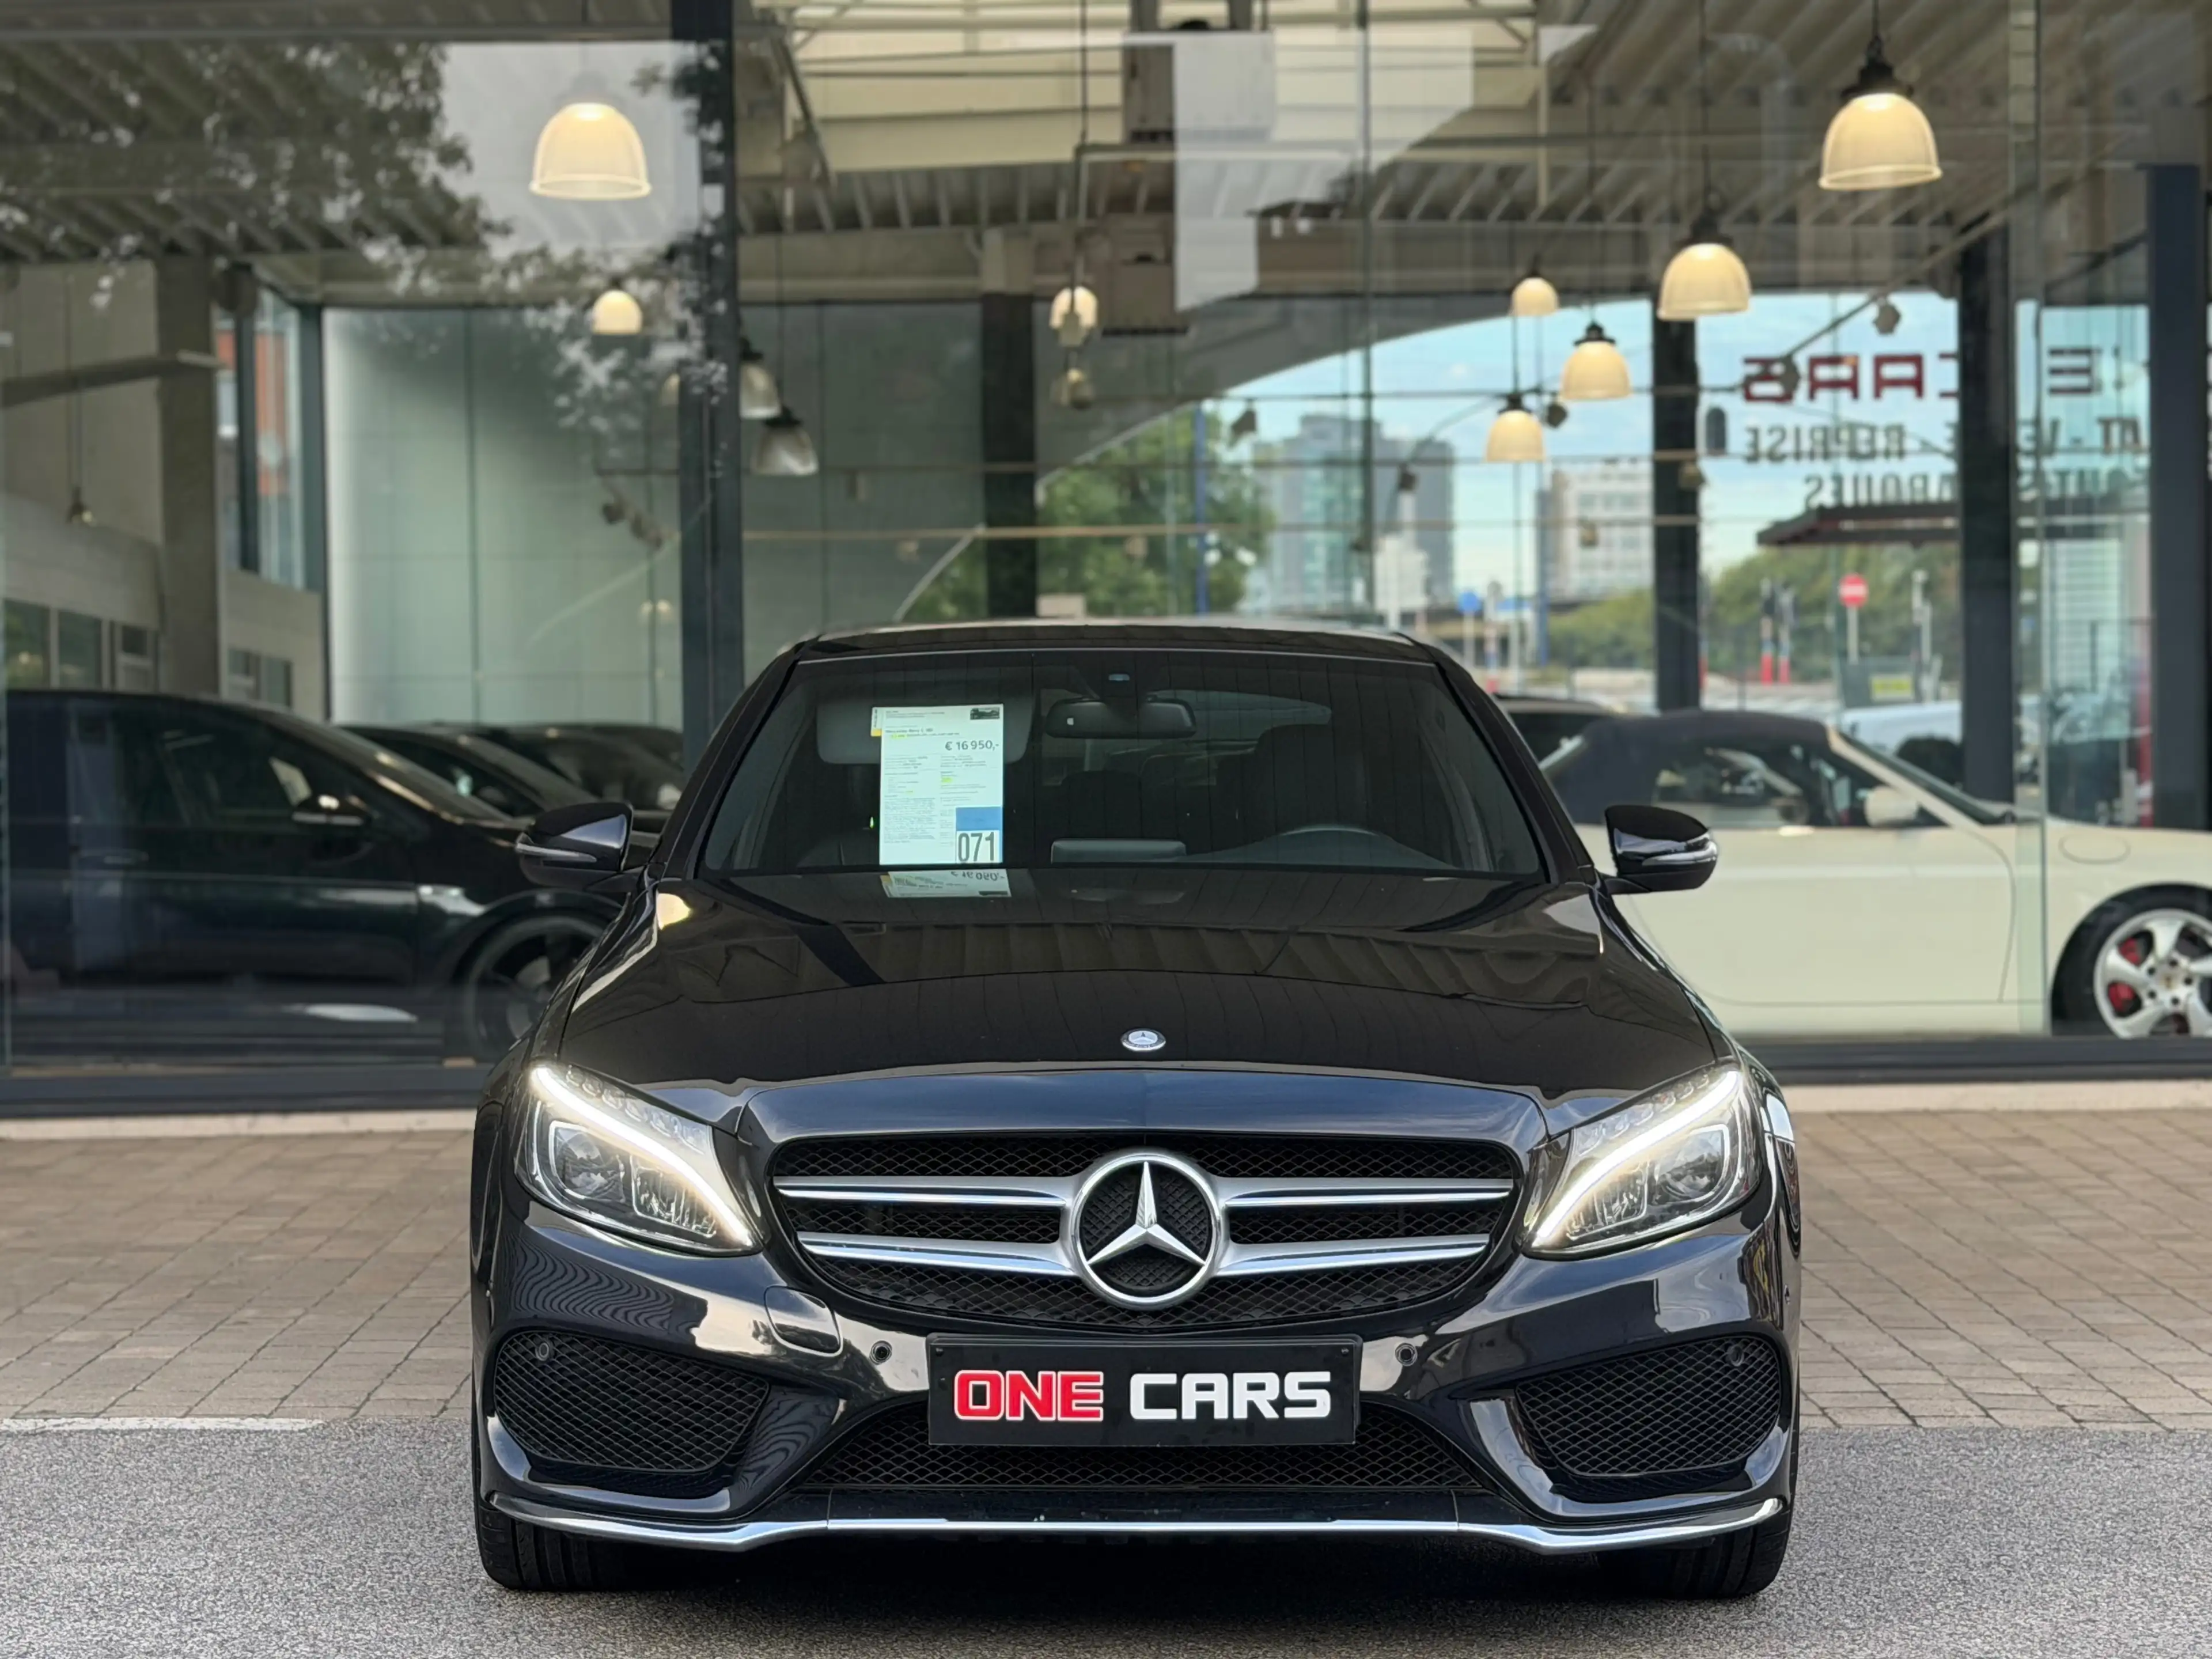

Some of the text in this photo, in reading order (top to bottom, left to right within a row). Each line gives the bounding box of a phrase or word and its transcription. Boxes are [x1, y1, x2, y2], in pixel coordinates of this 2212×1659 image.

[958, 832, 995, 862] 071
[953, 1370, 1331, 1422] ONE CARS
